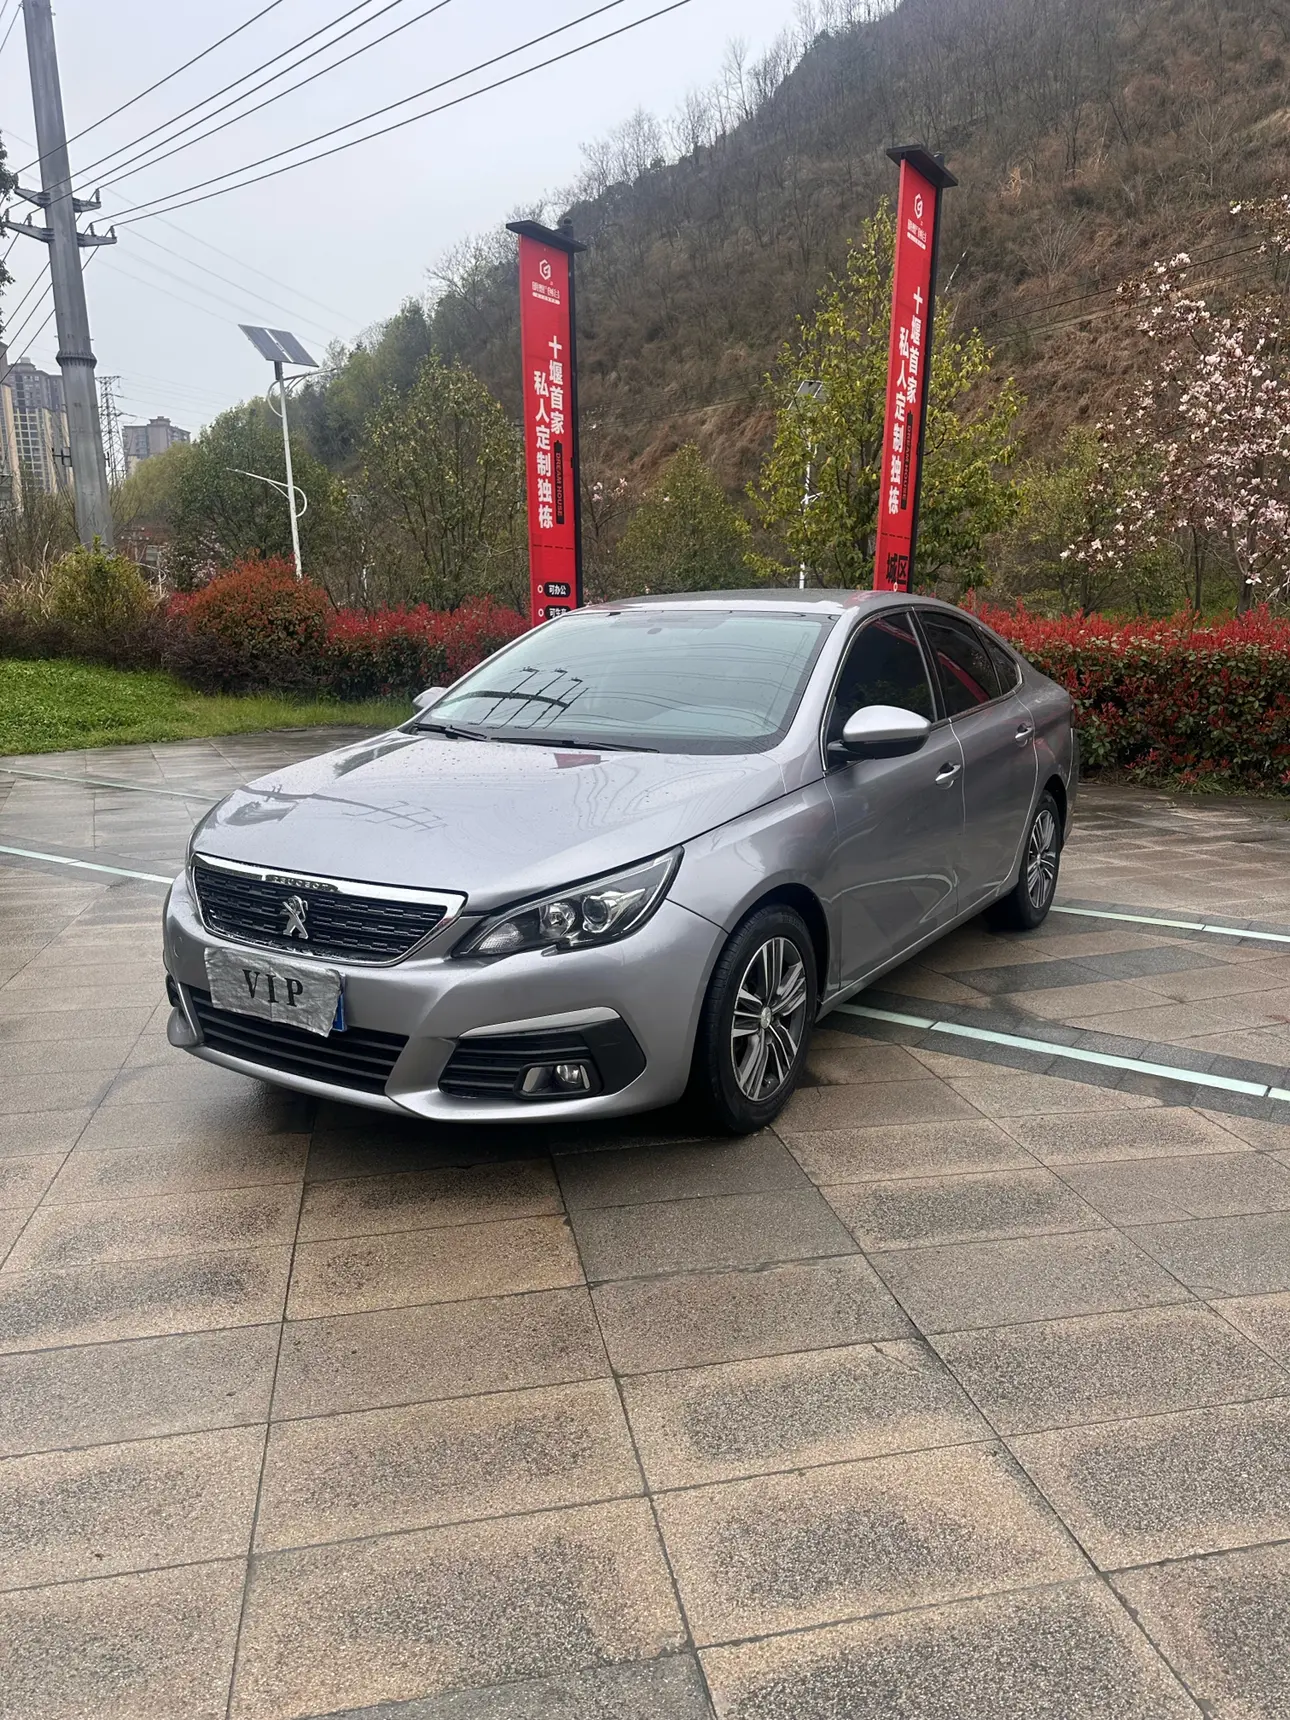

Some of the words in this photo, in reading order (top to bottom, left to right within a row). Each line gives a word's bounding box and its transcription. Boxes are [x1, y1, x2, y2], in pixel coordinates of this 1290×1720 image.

[548, 335, 564, 435] 十堰首家
[906, 286, 923, 404] 十堰首家
[533, 370, 554, 529] 私人定制独栋
[888, 327, 909, 515] 私人定制独栋
[548, 584, 567, 595] 可办公
[886, 552, 908, 584] 城区
[243, 969, 303, 1007] VIP
